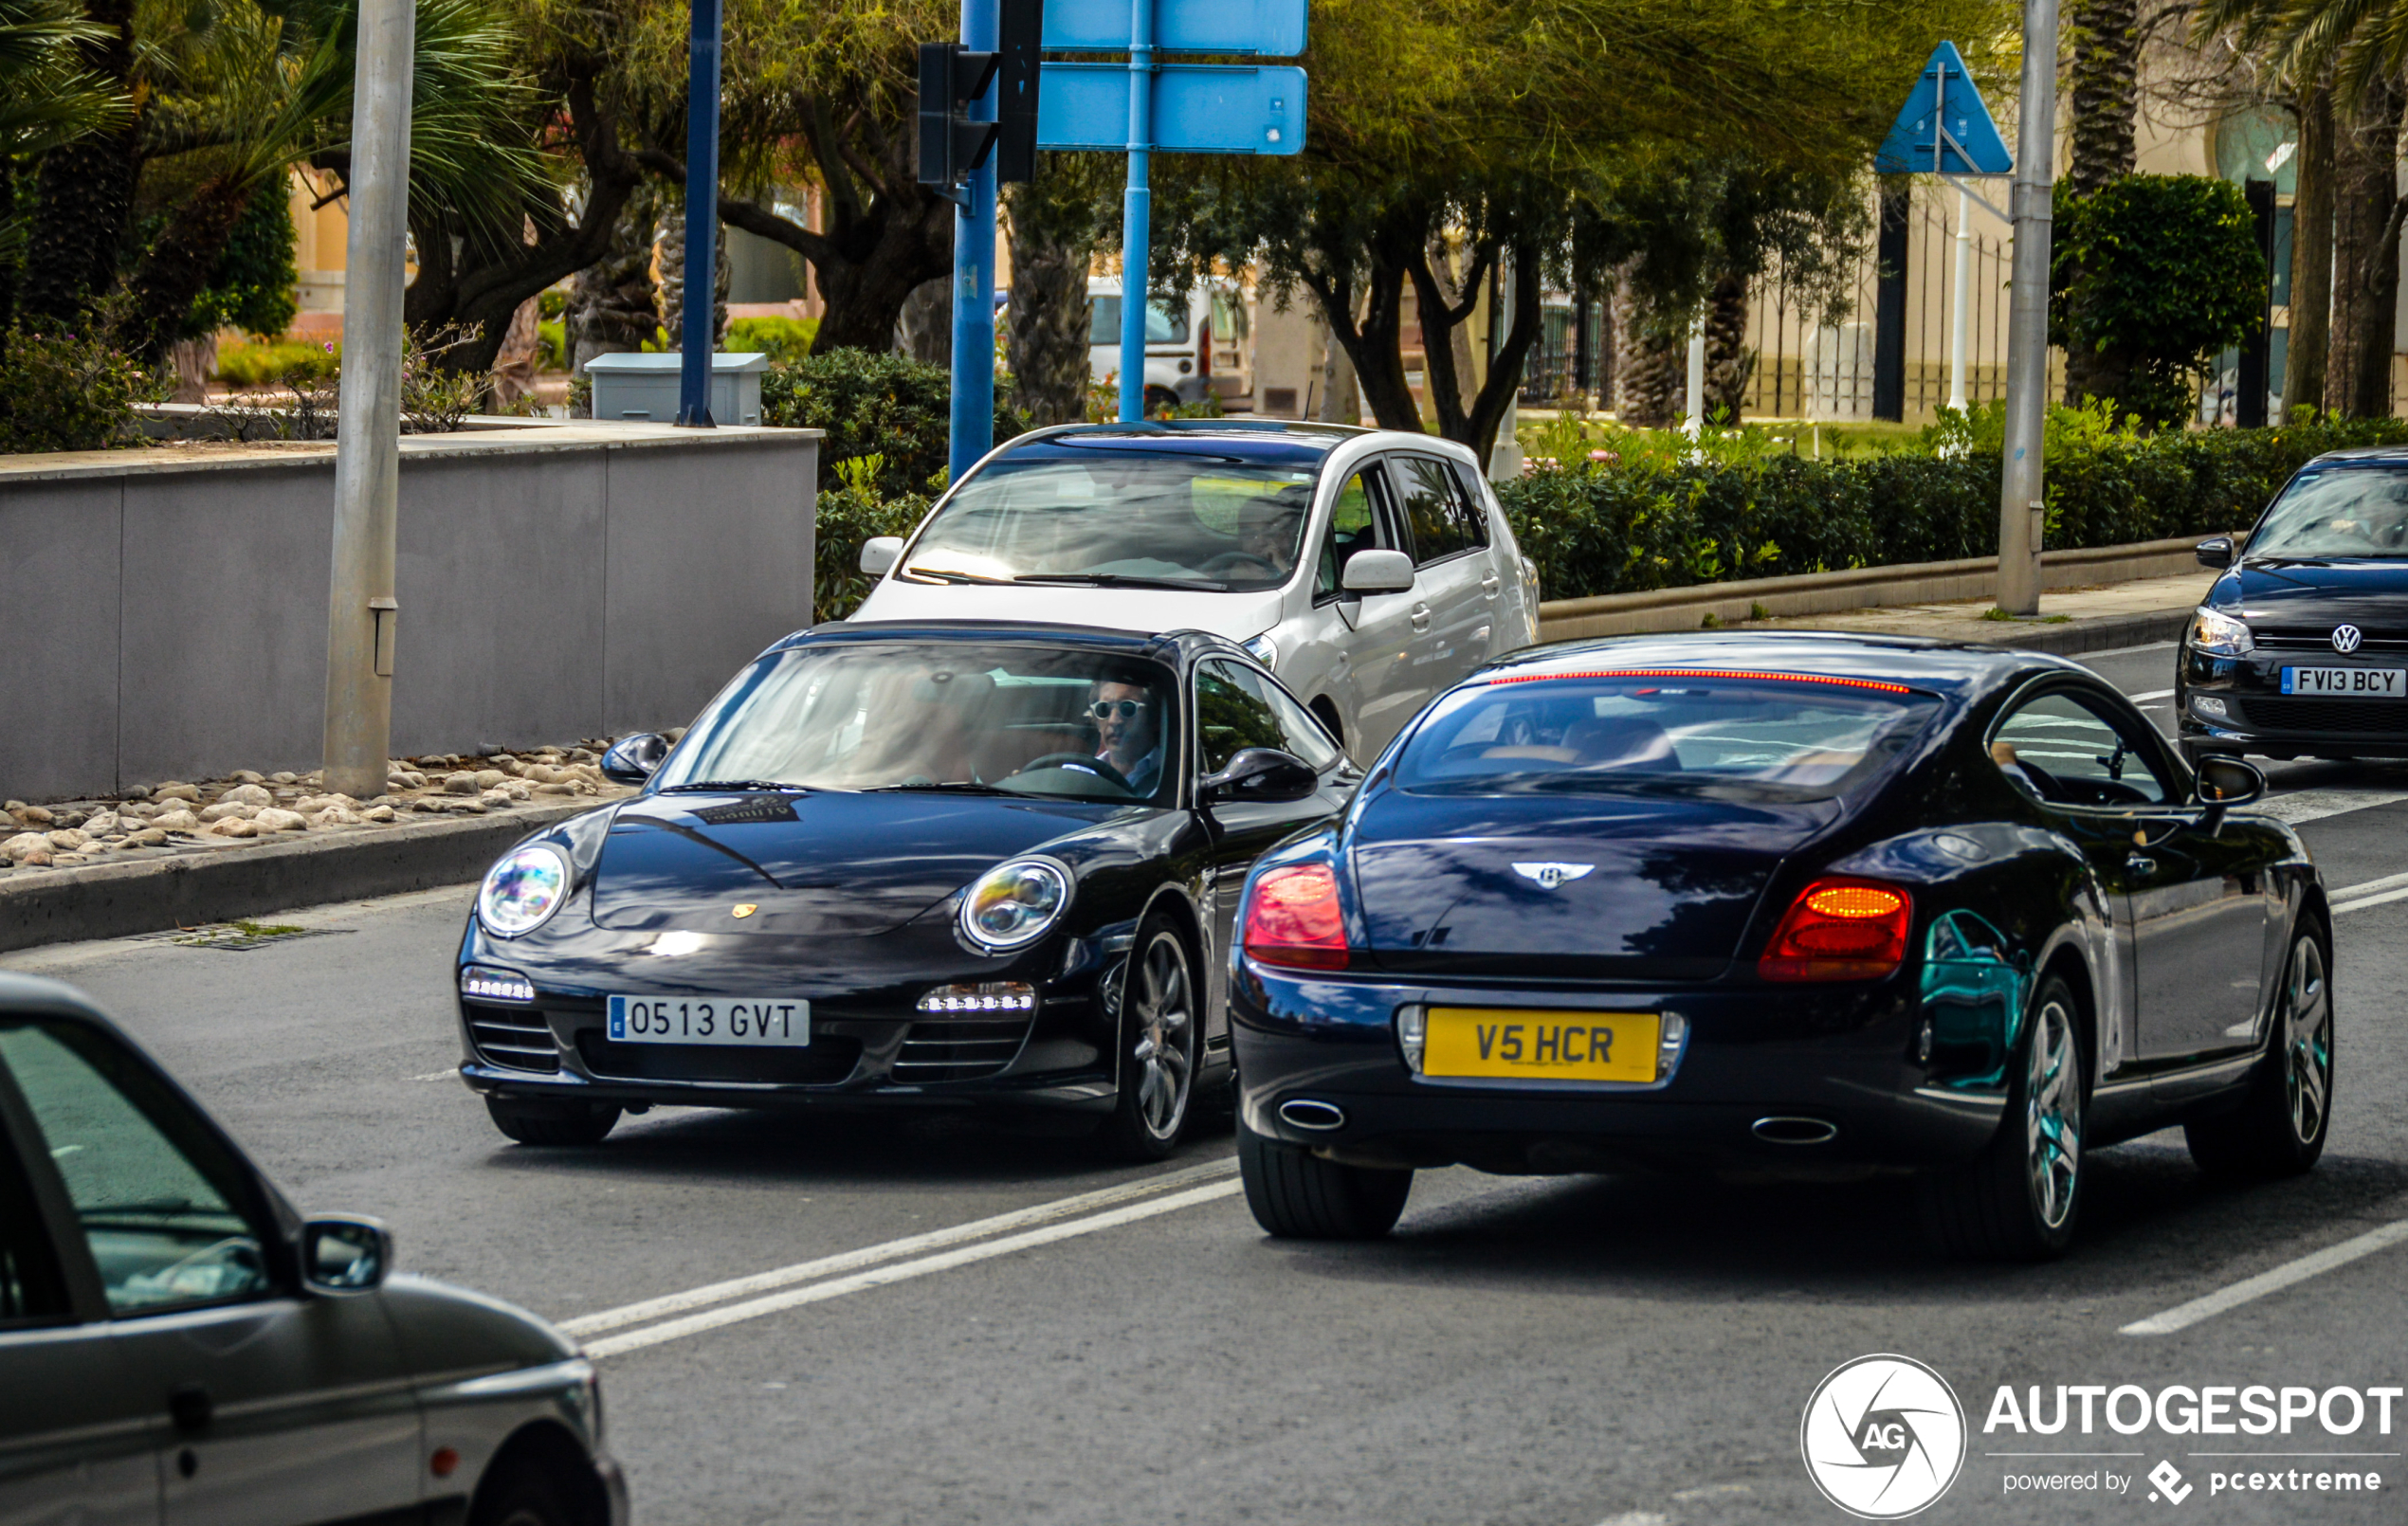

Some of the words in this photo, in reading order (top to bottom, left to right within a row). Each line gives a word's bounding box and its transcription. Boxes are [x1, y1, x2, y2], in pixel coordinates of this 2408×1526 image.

[2299, 670, 2346, 690] FV13
[2353, 671, 2396, 692] BCY
[613, 1022, 621, 1032] E
[632, 1002, 714, 1036] 0513
[730, 1005, 795, 1038] GVT
[1476, 1024, 1524, 1061] V5
[1535, 1026, 1614, 1063] HCR
